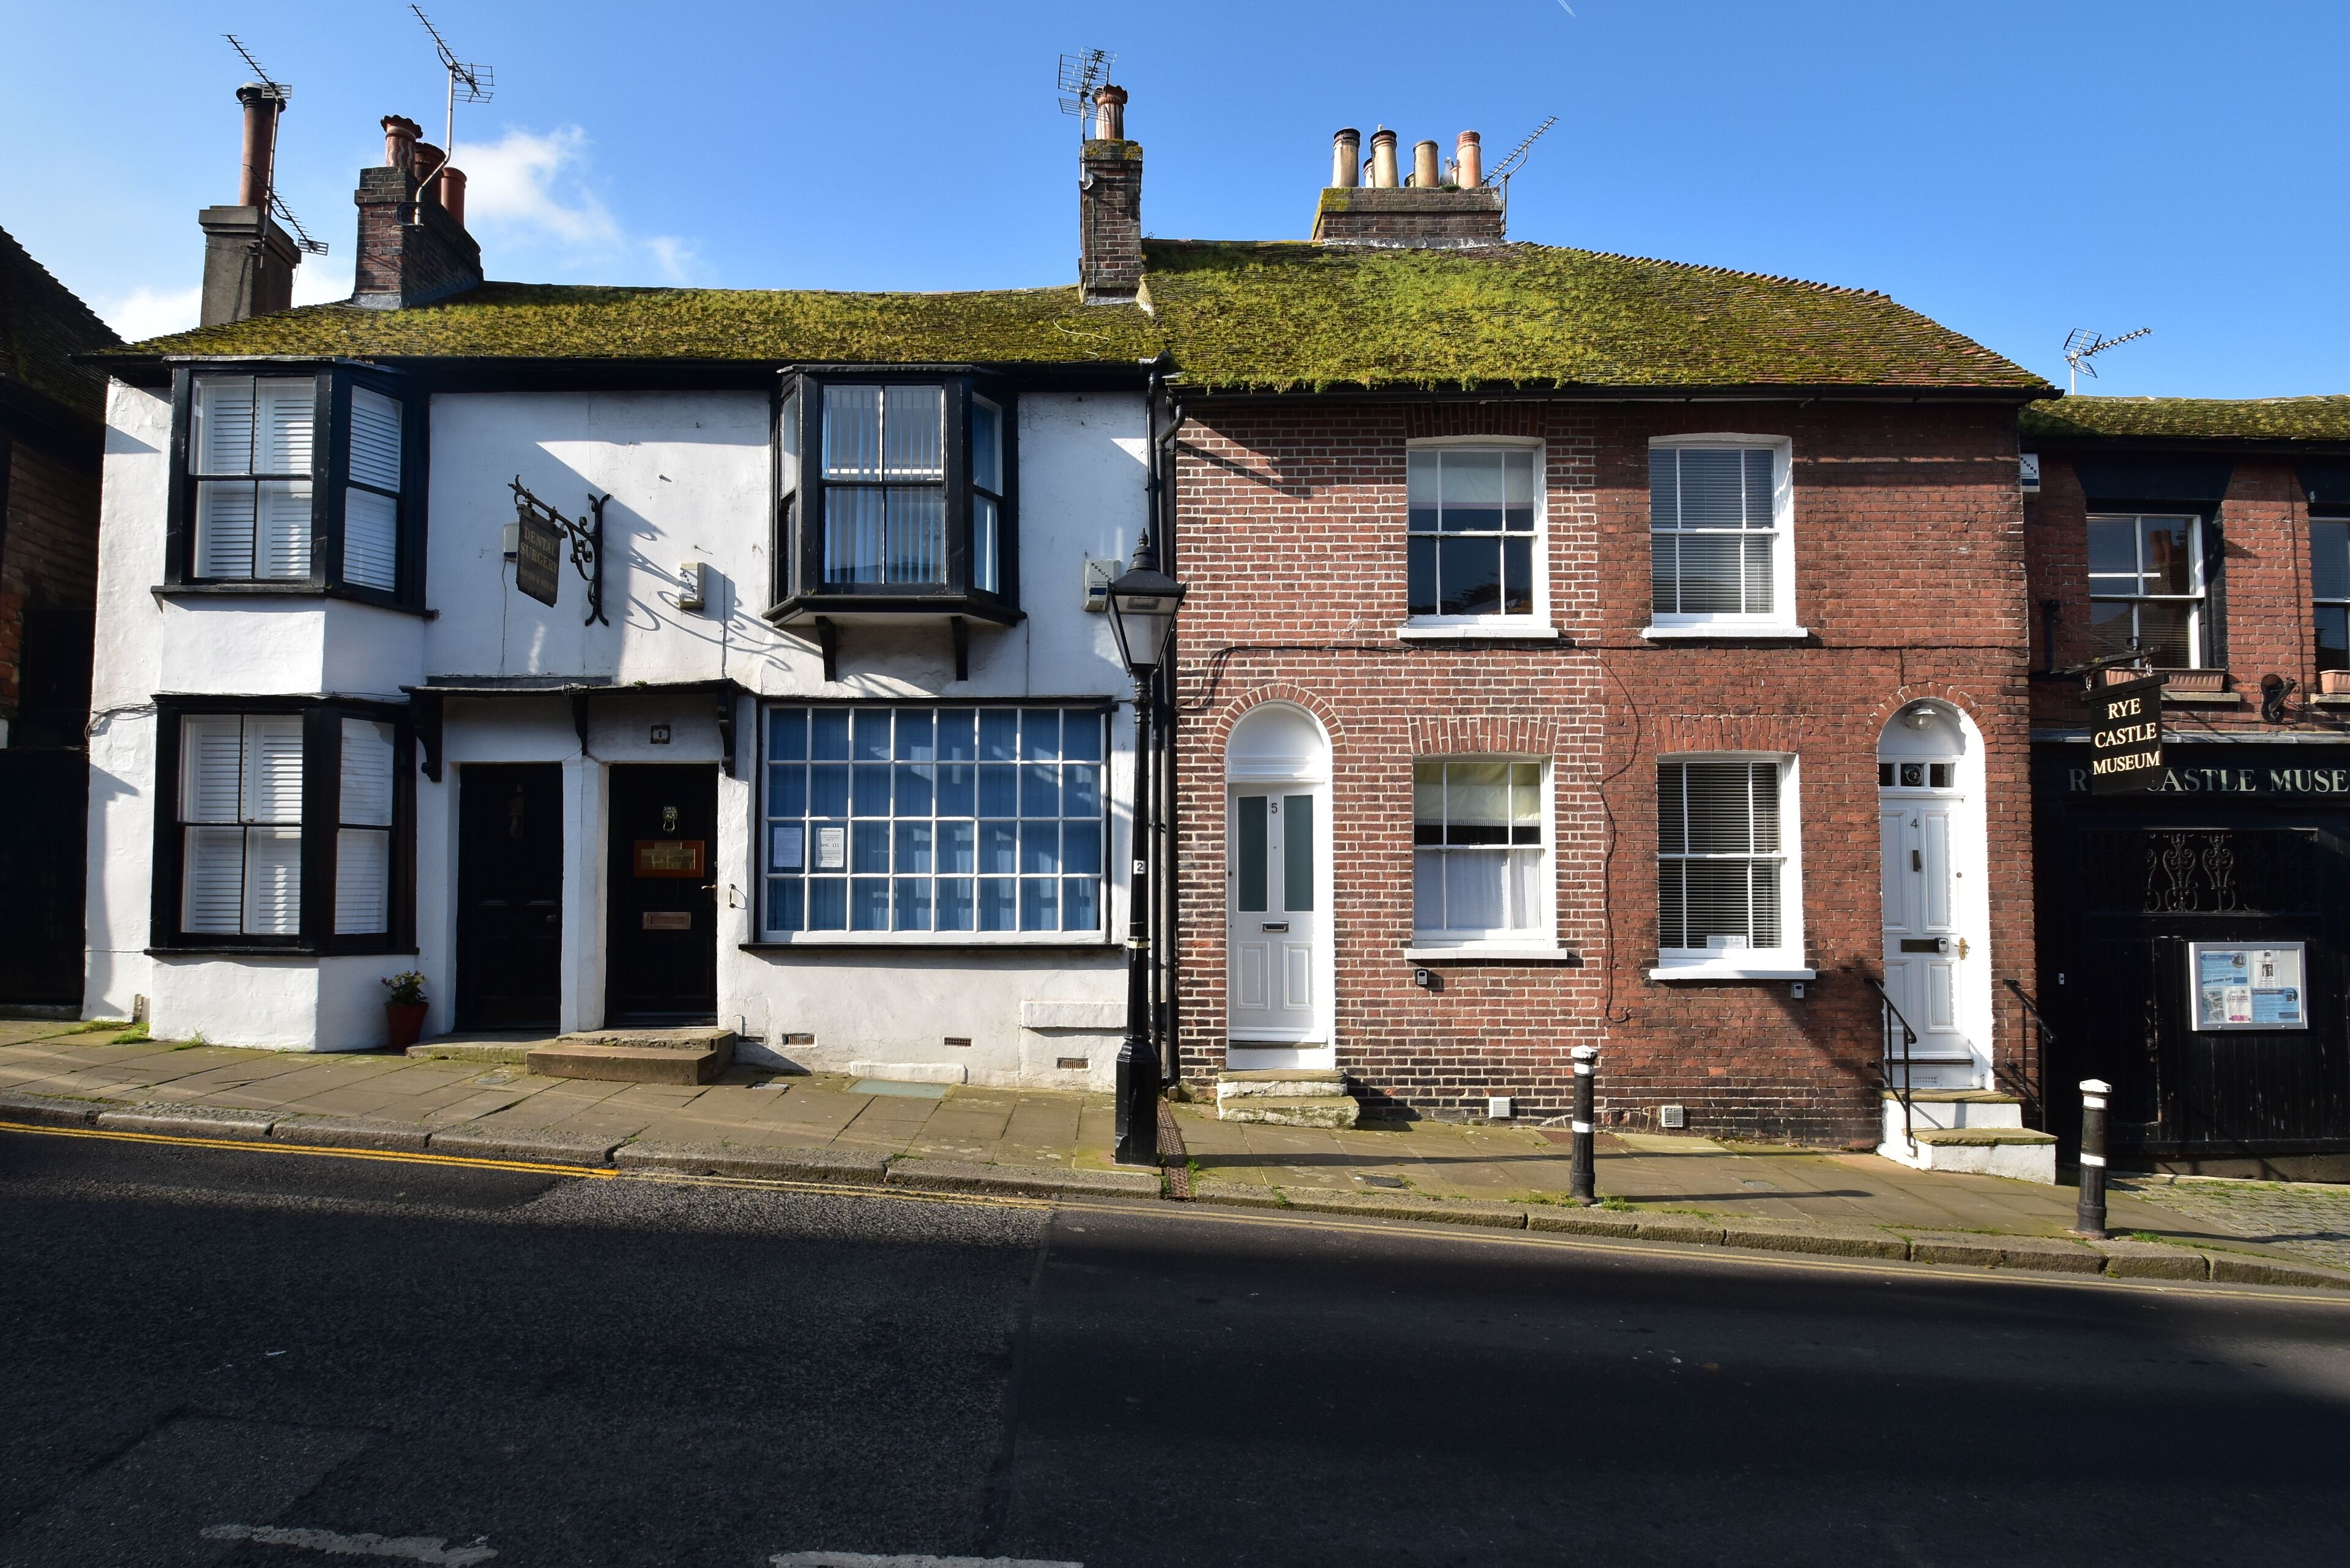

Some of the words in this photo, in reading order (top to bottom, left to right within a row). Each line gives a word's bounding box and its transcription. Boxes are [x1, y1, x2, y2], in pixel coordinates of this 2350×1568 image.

[2020, 457, 2037, 473] ESURE
[524, 526, 556, 557] DENTAL
[520, 542, 559, 574] SURGERY
[1091, 562, 1112, 581] BESURE
[2107, 698, 2141, 719] RYE
[2094, 722, 2157, 748] CASTLE
[2093, 751, 2161, 775] MUSEUM
[2147, 769, 2256, 791] ASTLE
[2270, 769, 2350, 792] MUSE
[1271, 802, 1278, 814] 5
[1910, 818, 1919, 829] 4
[1137, 862, 1144, 872] 2
